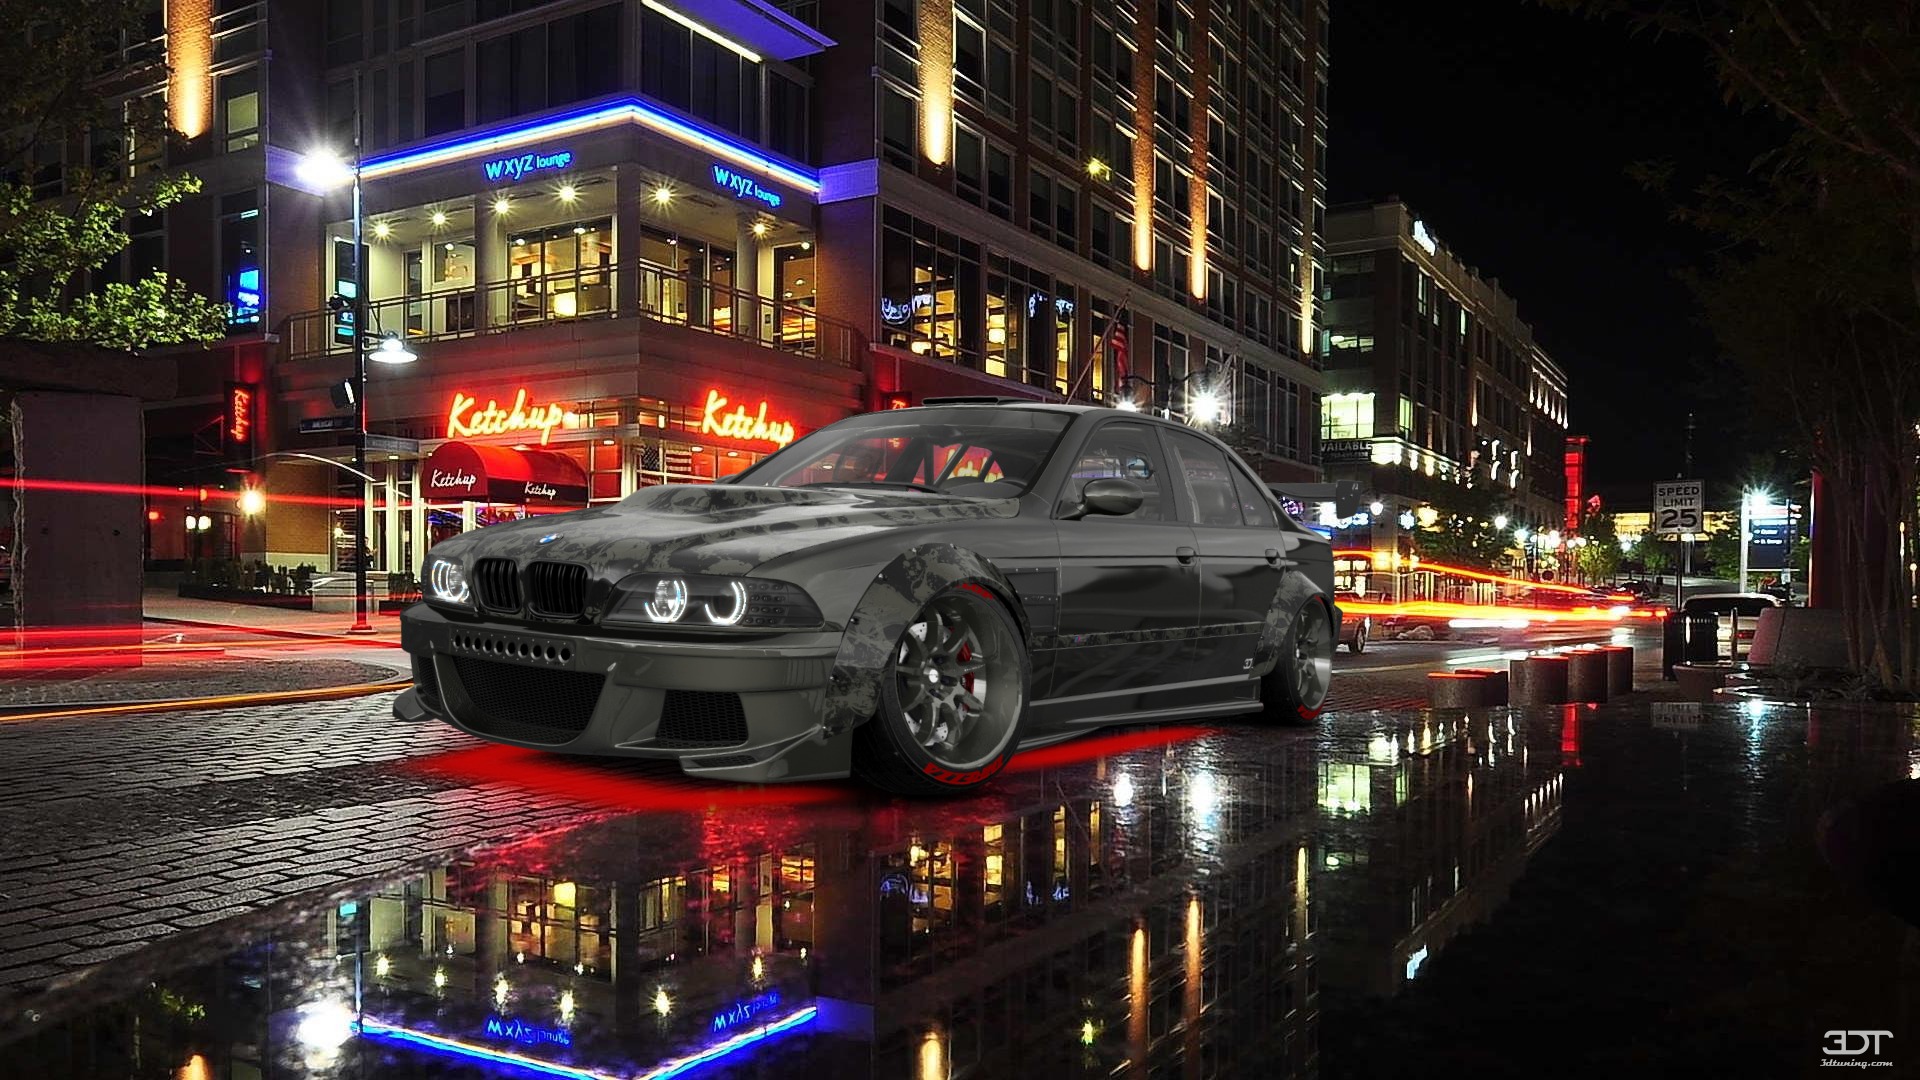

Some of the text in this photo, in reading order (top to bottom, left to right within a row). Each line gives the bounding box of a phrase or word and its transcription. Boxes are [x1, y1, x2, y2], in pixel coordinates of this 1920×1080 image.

[536, 152, 571, 168] lounge
[754, 184, 780, 207] lounge
[230, 389, 249, 440] Ketchup
[447, 388, 562, 446] Ketchup
[702, 389, 794, 449] Ketchup
[1319, 441, 1373, 452] VAILABLE
[430, 468, 477, 492] Ketchup
[524, 481, 557, 500] Ketchup
[1658, 486, 1700, 496] SPEED
[1663, 497, 1695, 507] LIMIT
[1661, 508, 1698, 528] 25
